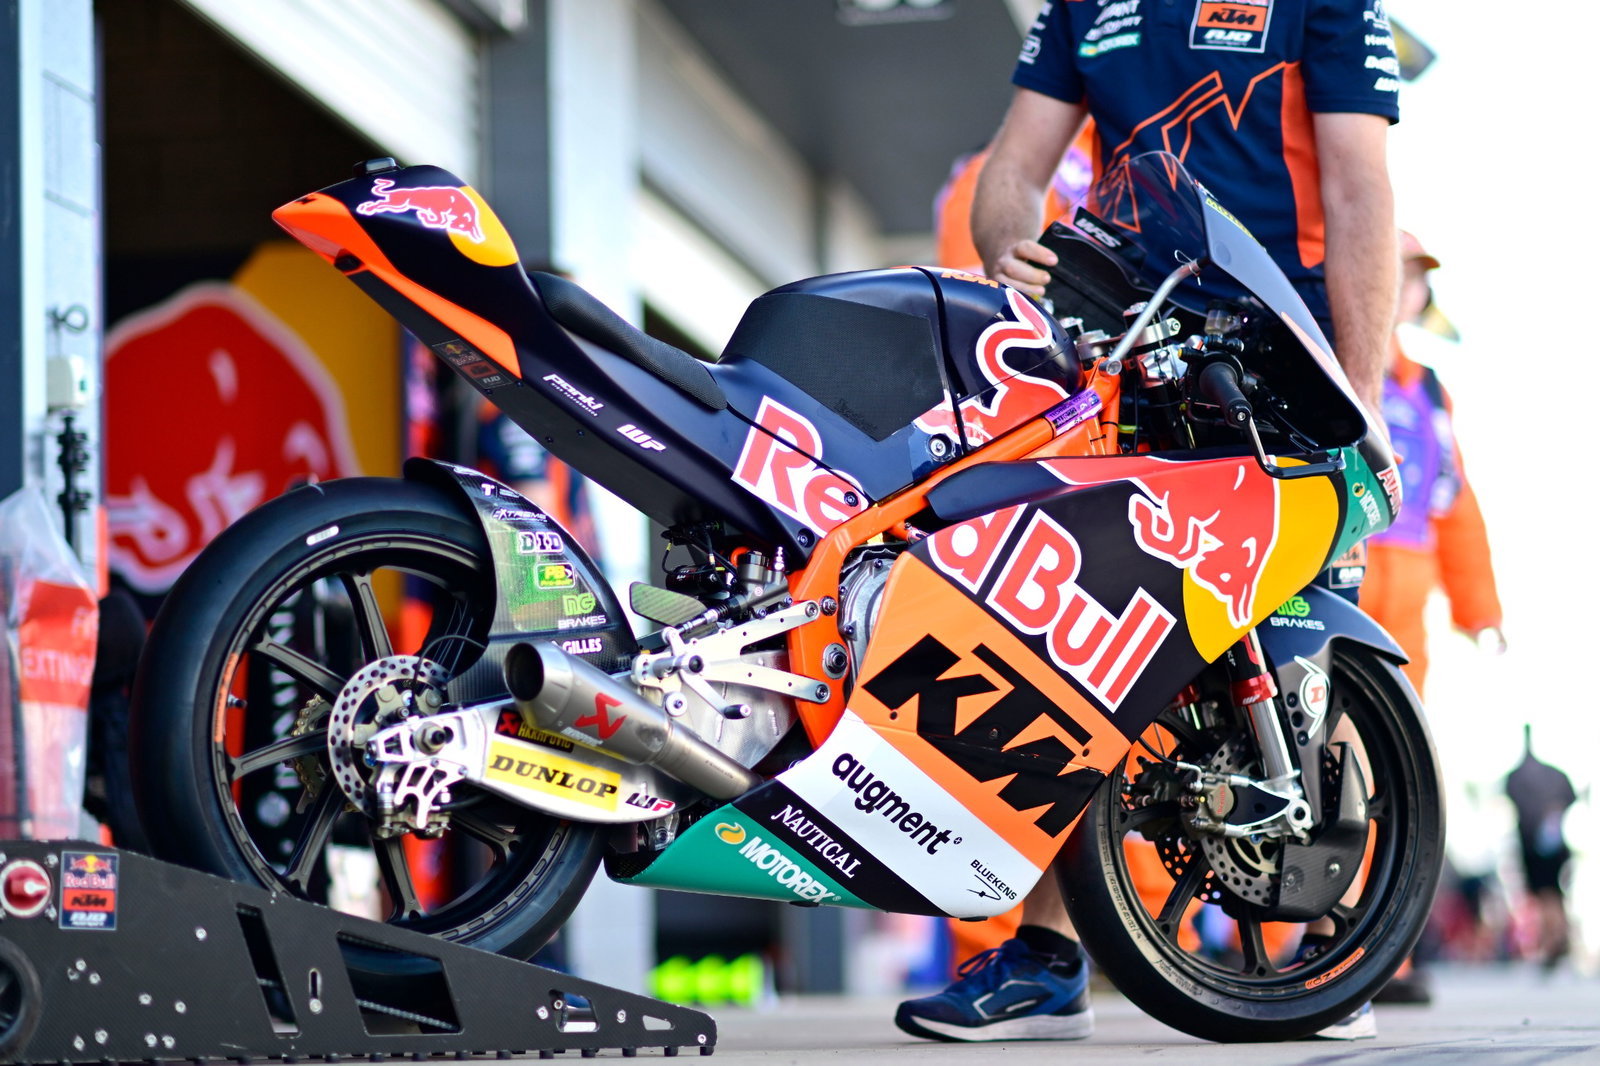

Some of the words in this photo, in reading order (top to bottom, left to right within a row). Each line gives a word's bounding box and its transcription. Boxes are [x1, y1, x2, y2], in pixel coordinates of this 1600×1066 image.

[1208, 8, 1257, 25] KTM
[616, 424, 667, 452] WP
[558, 615, 606, 630] BRAKES
[985, 508, 1178, 714] Bull
[1269, 616, 1326, 631] BRAKES
[862, 633, 1109, 838] KTM
[489, 754, 618, 798] DUNLOP
[831, 752, 953, 856] augment
[771, 805, 863, 879] NAUTICAL
[970, 858, 1017, 901] BLUEKENS
